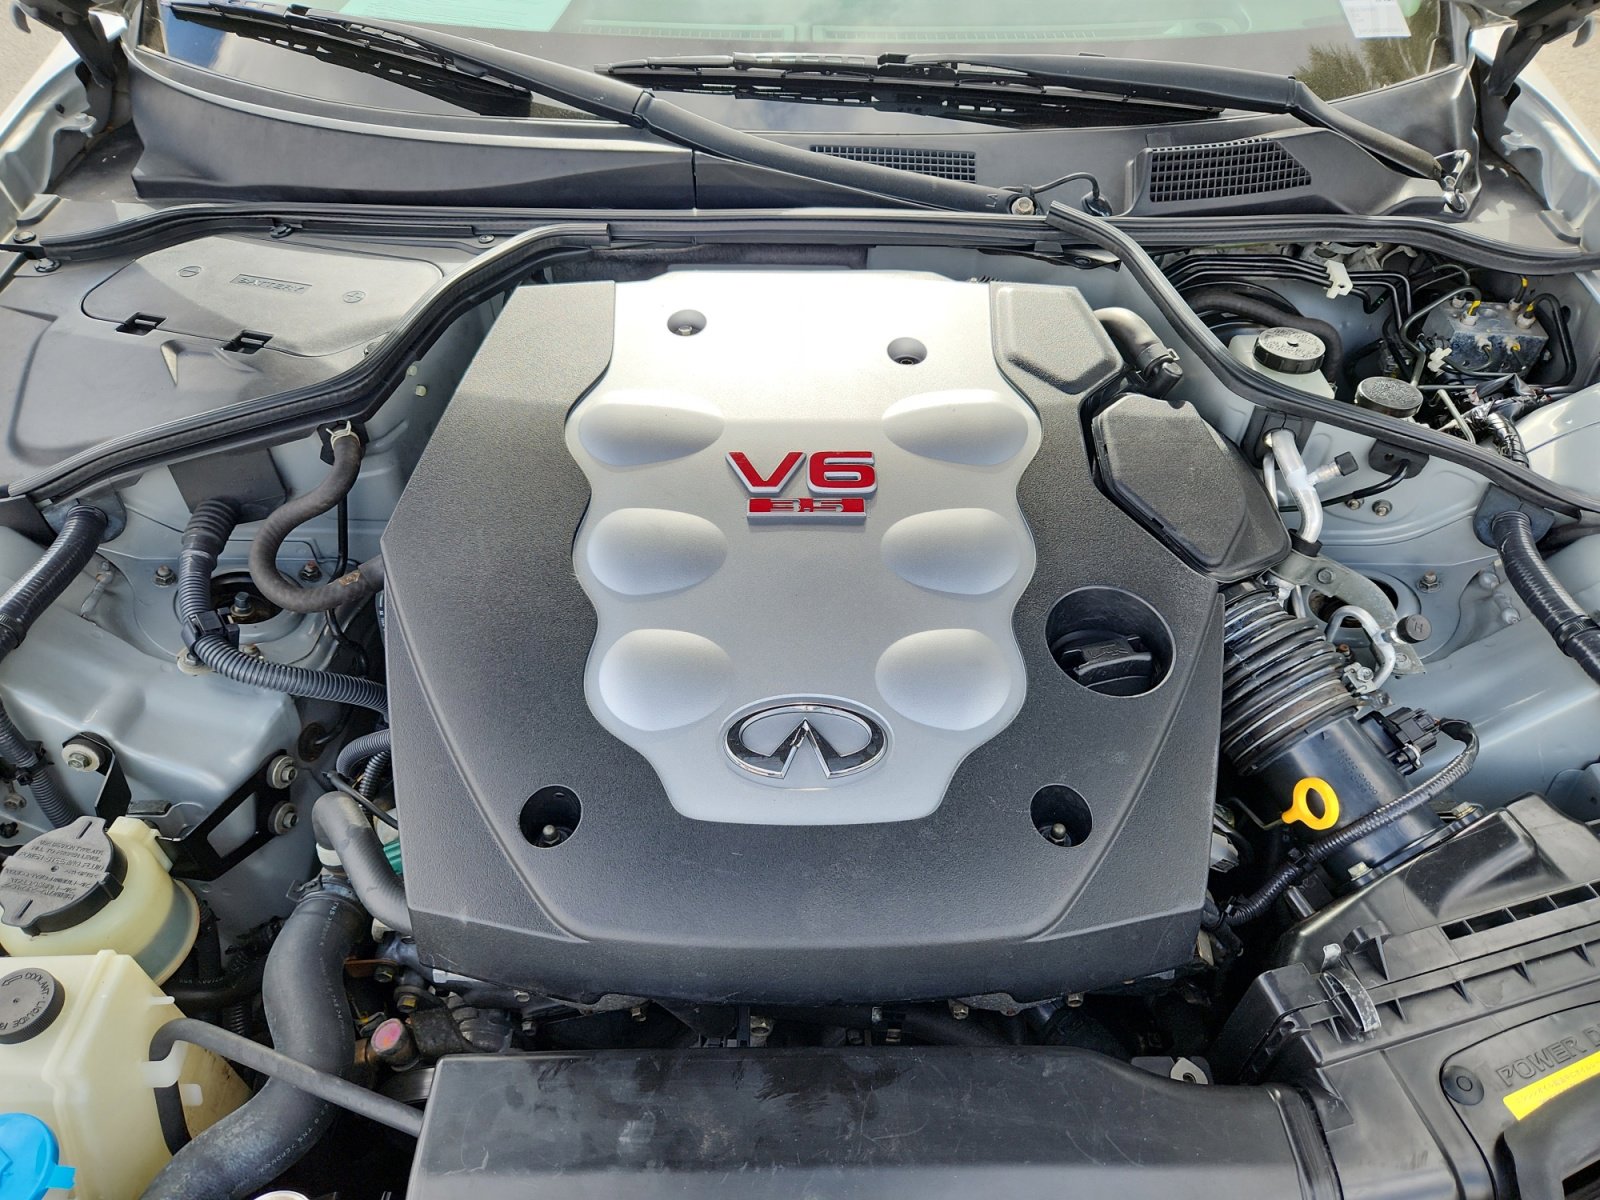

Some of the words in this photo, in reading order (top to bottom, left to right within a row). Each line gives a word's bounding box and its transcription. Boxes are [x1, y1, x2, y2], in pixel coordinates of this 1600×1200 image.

[238, 277, 305, 294] BATTERY
[725, 451, 878, 495] V6
[770, 498, 844, 513] 3.5
[25, 972, 50, 996] COOLANT
[12, 1001, 46, 1029] LIQUIDE
[1495, 1036, 1588, 1088] POWER
[1582, 1023, 1600, 1047] D
